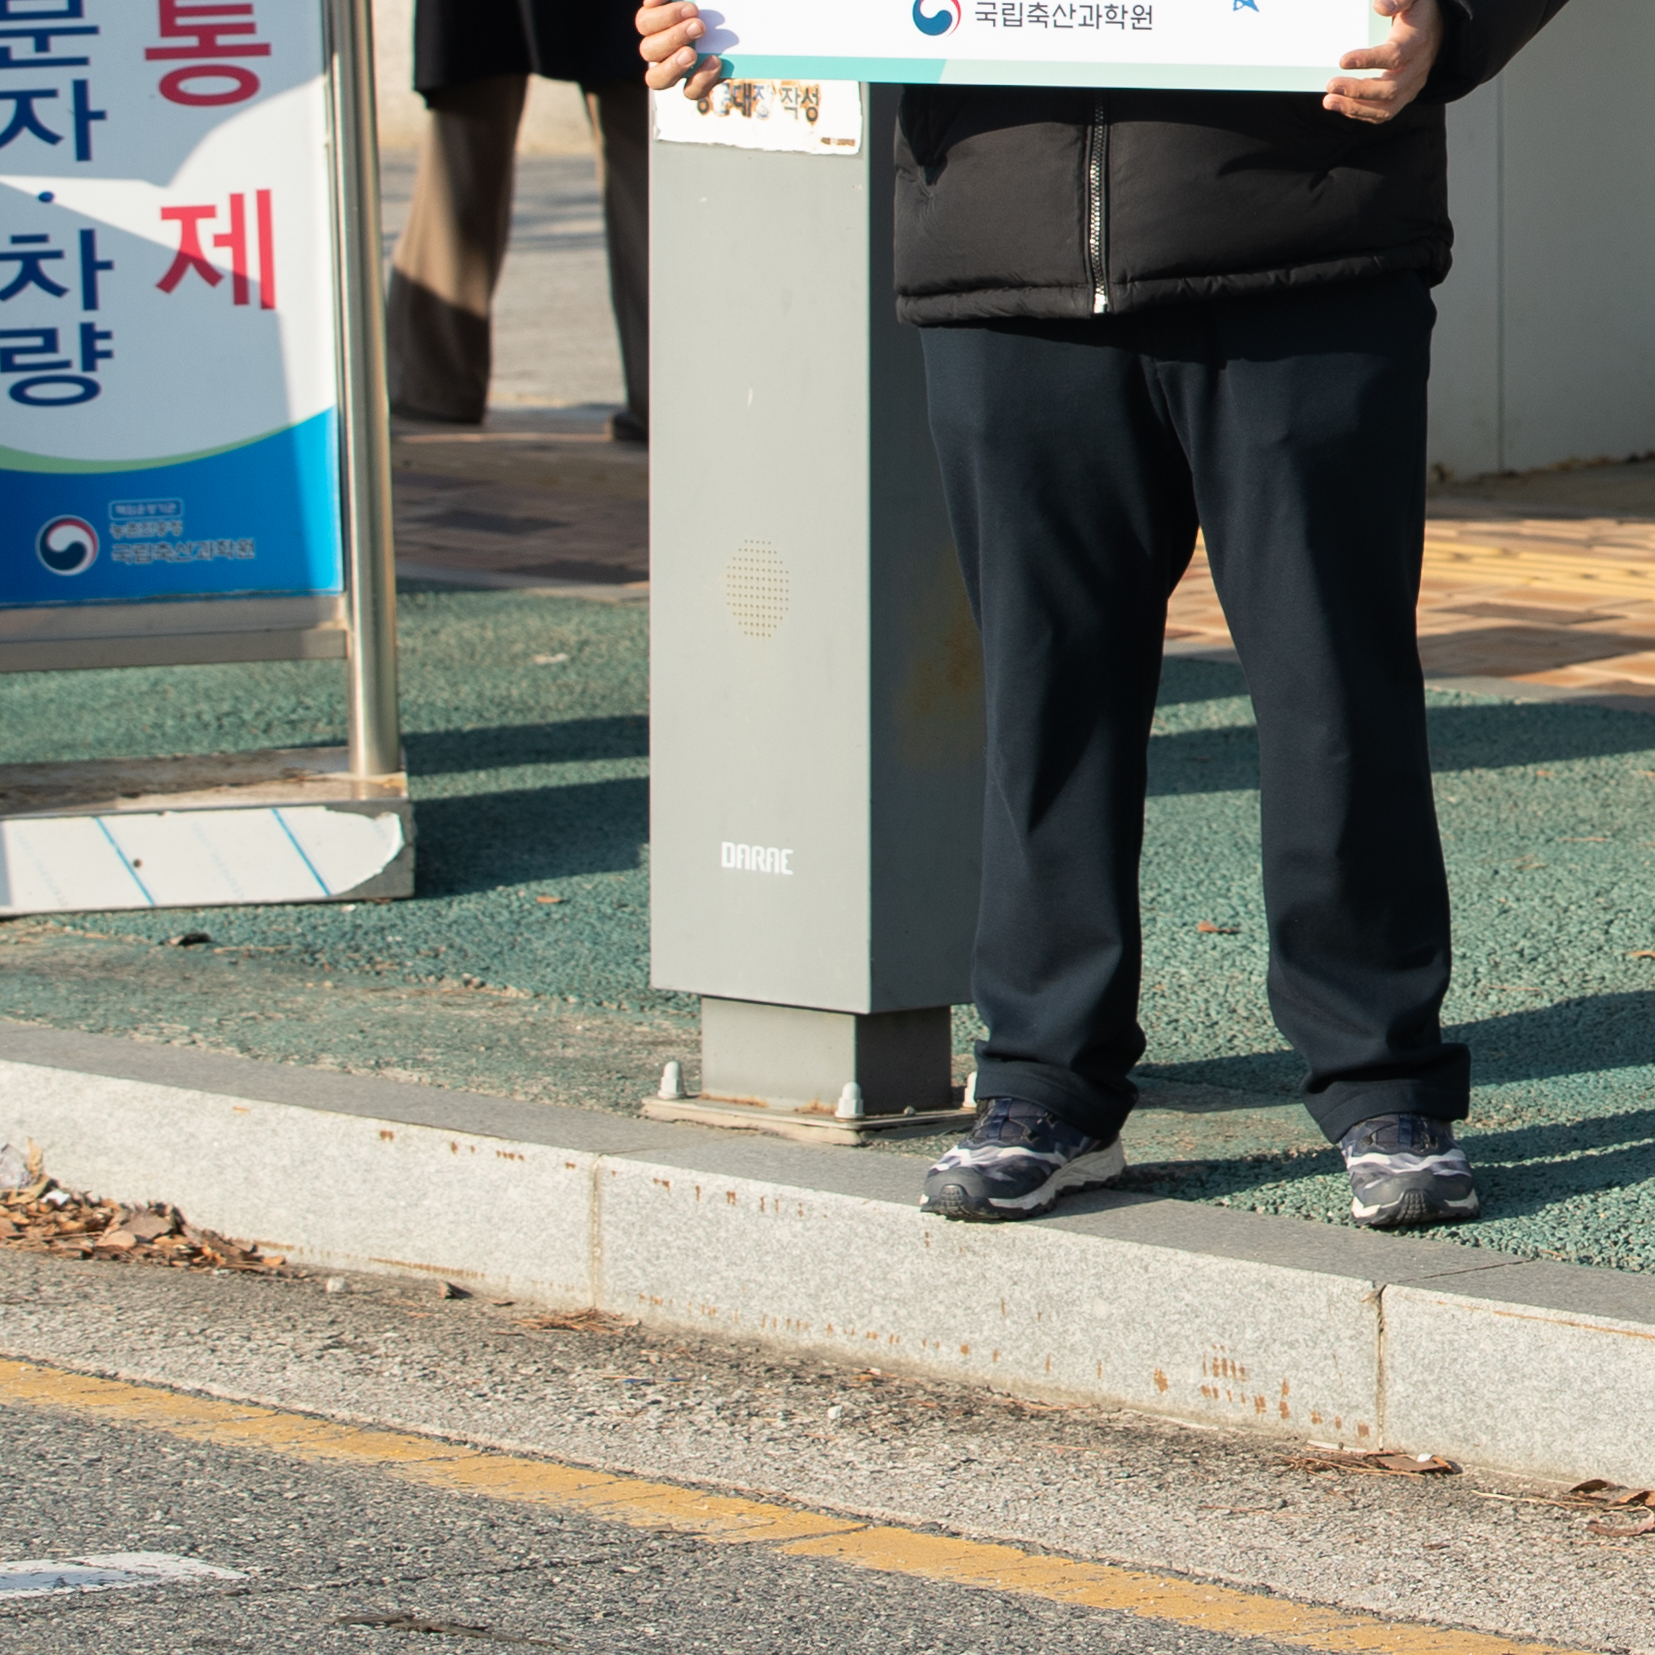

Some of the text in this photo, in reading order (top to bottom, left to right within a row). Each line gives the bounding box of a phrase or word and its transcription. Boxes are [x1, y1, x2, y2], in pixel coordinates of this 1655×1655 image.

[975, 2, 1152, 30] 국립축산과학원
[780, 83, 820, 123] 작성
[112, 538, 255, 564] 국립축산과학원
